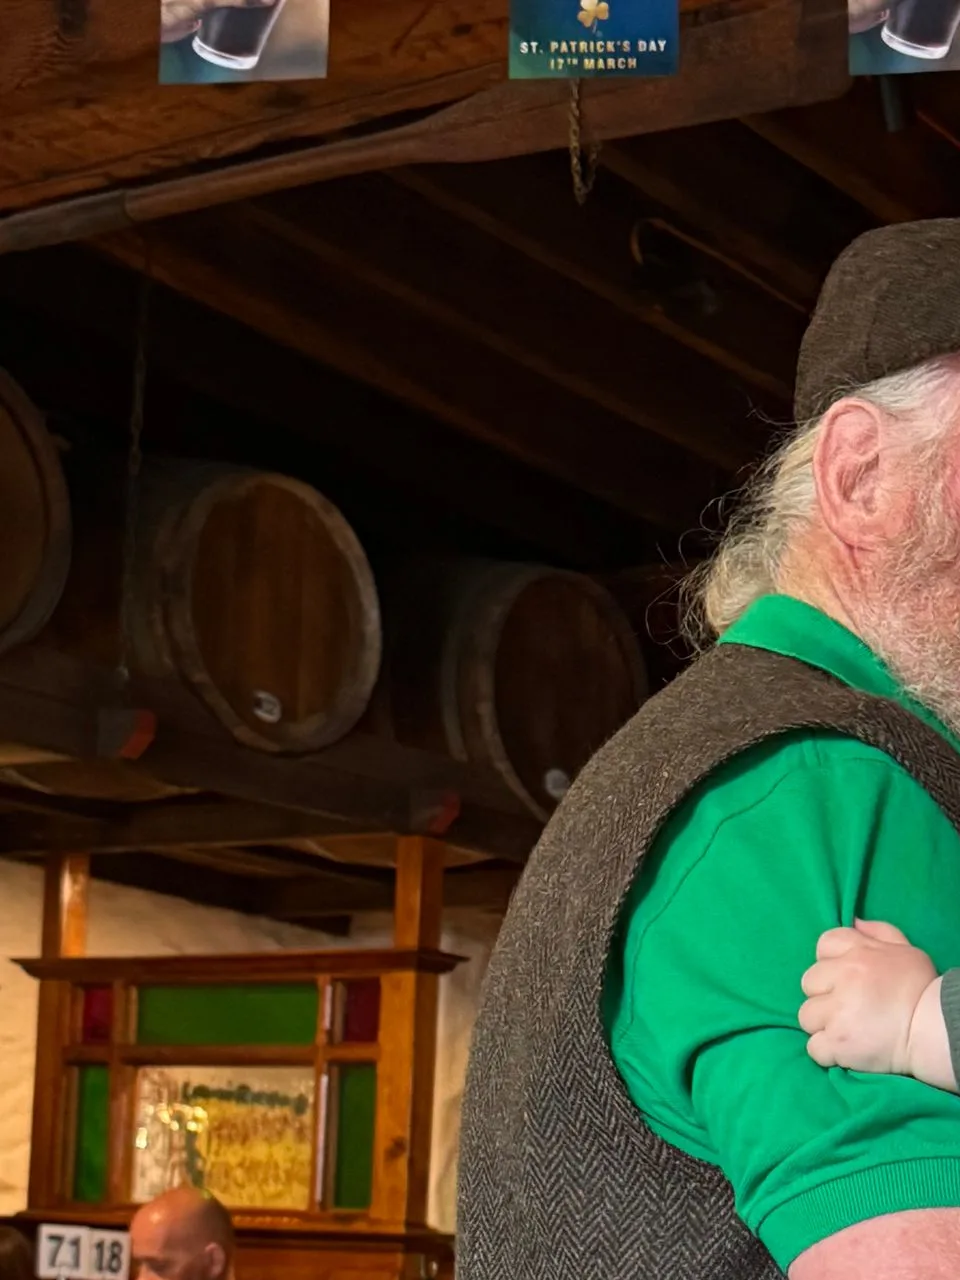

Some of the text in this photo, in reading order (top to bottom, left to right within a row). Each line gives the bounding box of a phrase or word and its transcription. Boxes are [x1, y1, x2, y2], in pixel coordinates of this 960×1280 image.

[520, 40, 667, 54] ST. PATRICK'S DAY
[584, 58, 637, 70] MARCH
[47, 1233, 81, 1270] 71
[95, 1240, 122, 1273] 18
